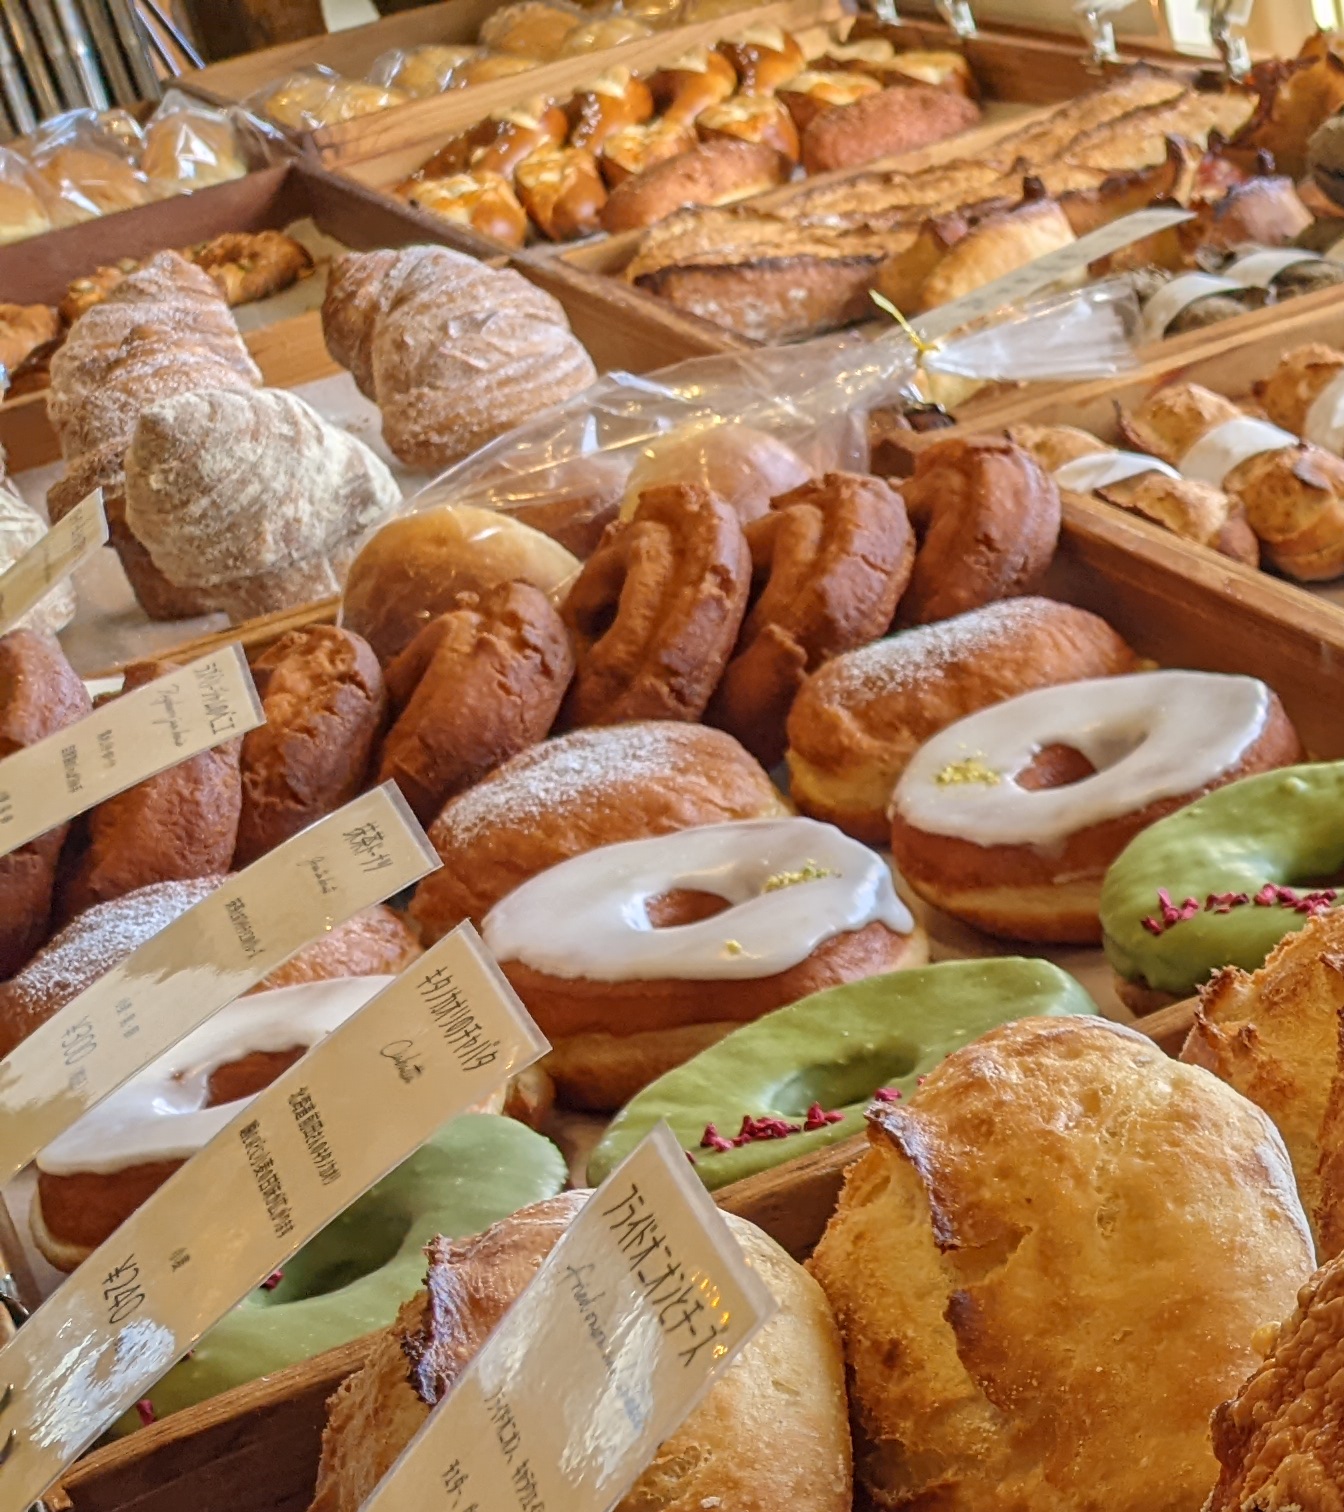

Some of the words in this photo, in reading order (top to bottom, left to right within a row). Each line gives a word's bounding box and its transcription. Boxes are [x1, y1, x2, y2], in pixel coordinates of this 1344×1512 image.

[61, 1015, 99, 1067] ¥300
[417, 966, 502, 1072] キタノカオリのチャバタ
[102, 1253, 146, 1325] ¥240
[602, 1183, 727, 1367] フライドオニオンとチーズ
